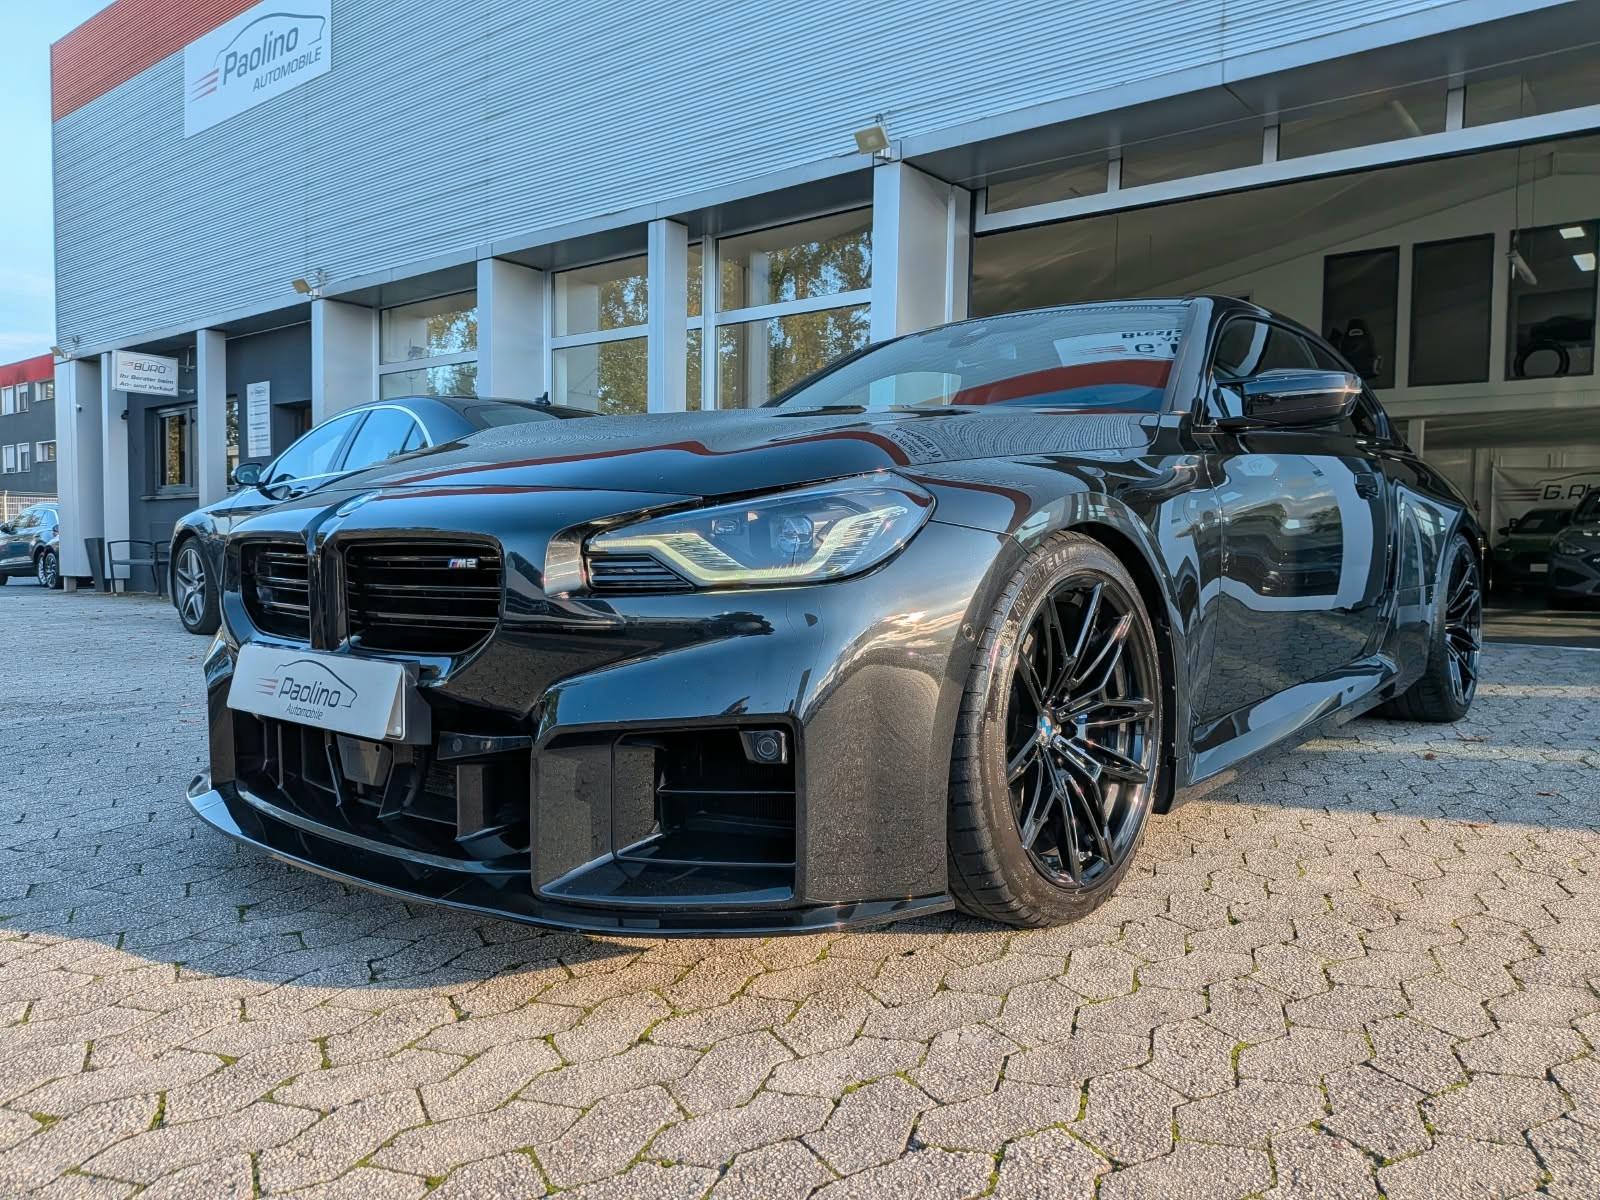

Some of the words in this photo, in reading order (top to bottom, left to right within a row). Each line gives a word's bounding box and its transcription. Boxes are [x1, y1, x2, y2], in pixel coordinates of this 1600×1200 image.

[223, 26, 299, 86] Paolino
[252, 46, 322, 92] AUTOMOBILE
[134, 361, 167, 374] BÜRO
[278, 676, 341, 708] Paolino
[285, 702, 324, 721] Automobile
